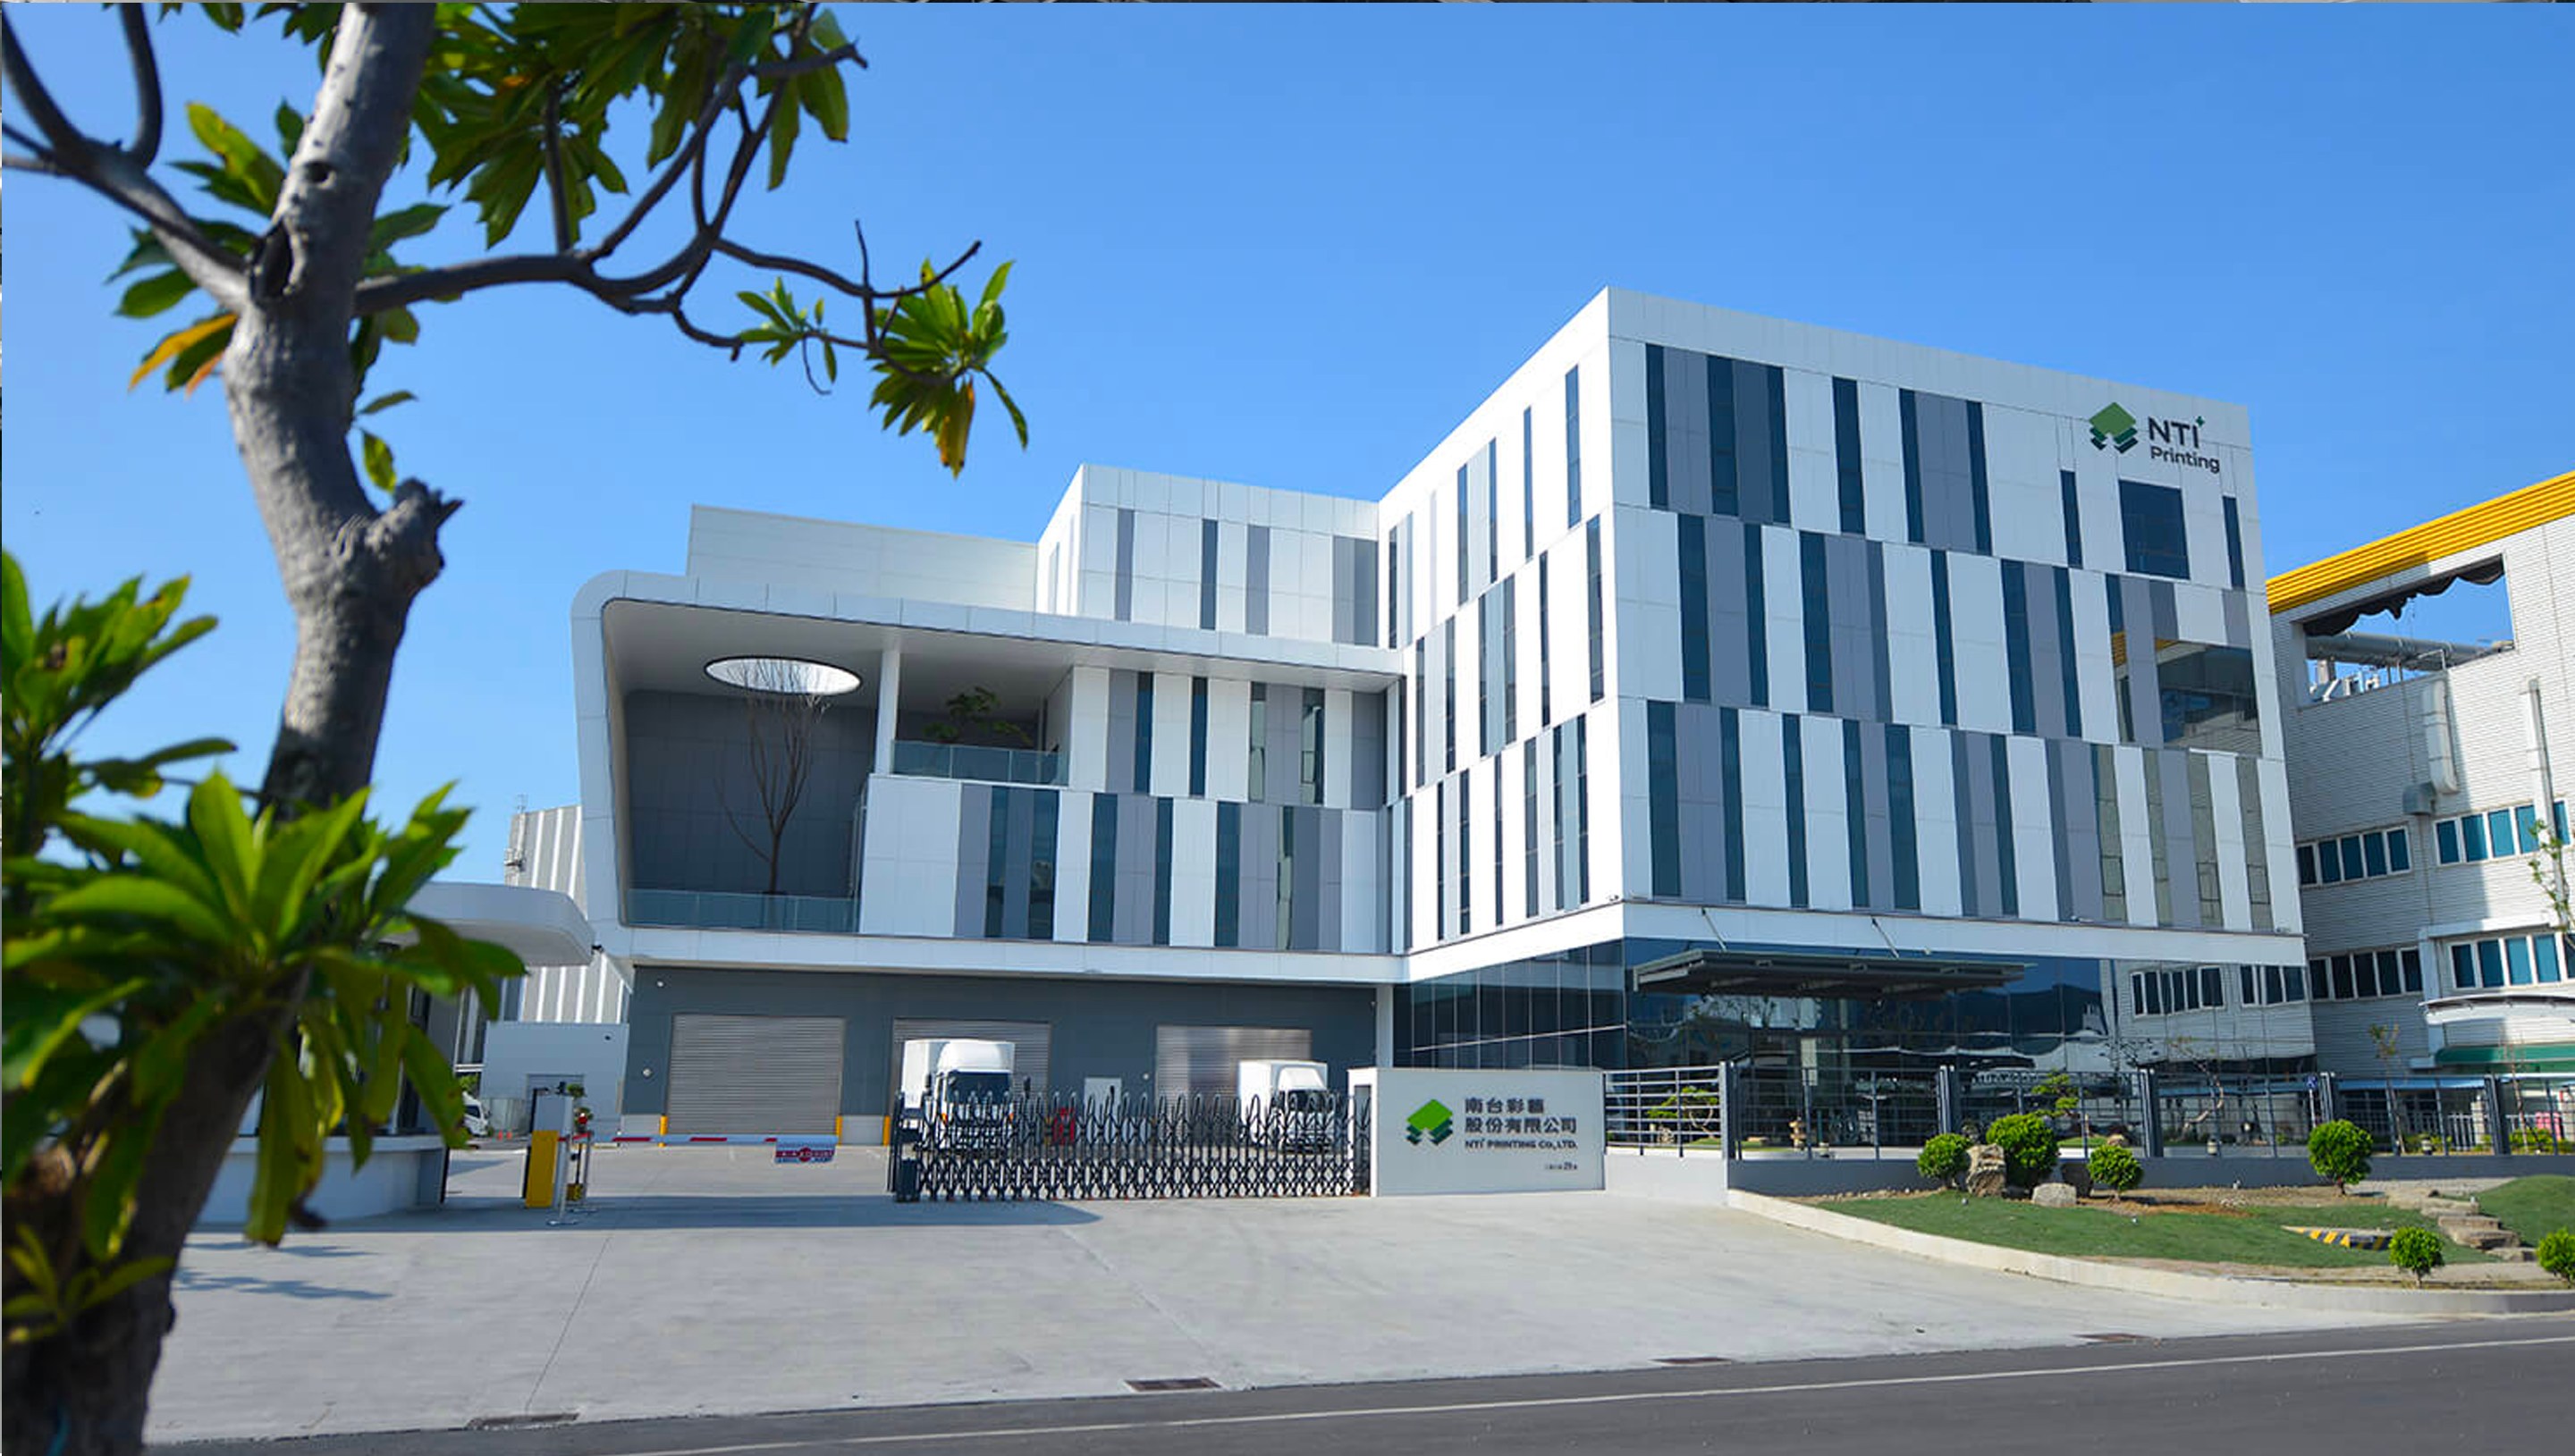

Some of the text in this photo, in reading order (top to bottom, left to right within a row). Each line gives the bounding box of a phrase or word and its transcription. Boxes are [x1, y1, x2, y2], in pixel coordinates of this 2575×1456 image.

[2150, 445, 2220, 474] Printing
[1465, 1117, 1576, 1133] 股份有限公司
